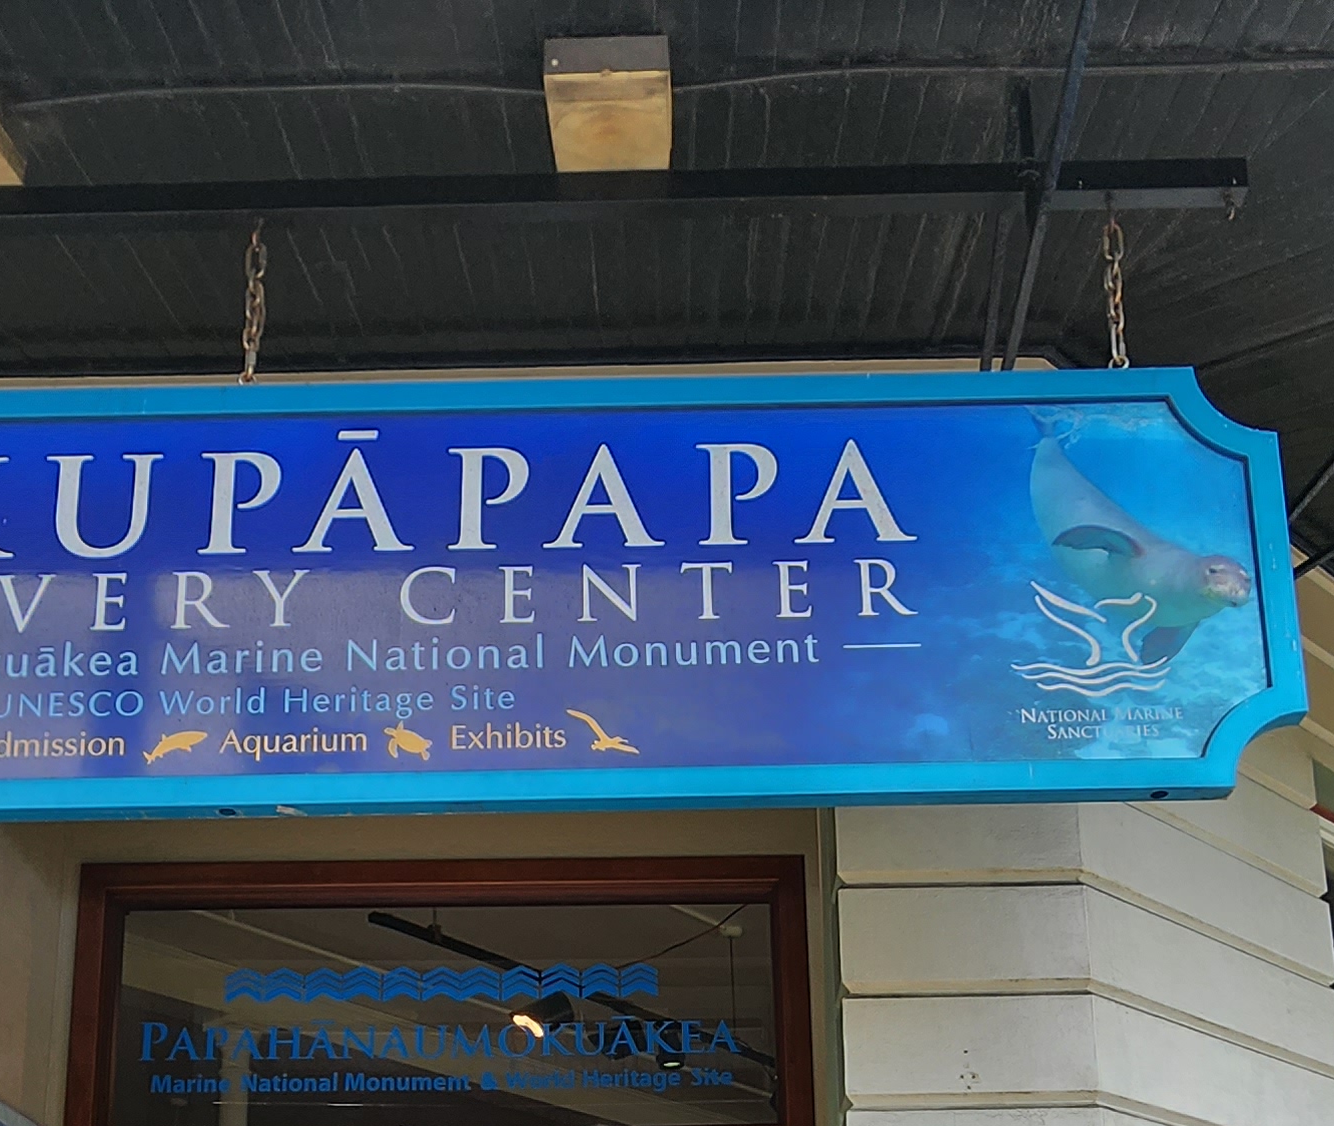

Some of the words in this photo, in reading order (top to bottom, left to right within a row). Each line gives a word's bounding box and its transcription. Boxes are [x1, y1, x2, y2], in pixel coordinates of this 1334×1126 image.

[399, 558, 918, 626] CENTER
[161, 640, 322, 675] Marine
[346, 633, 544, 672] National
[569, 631, 819, 668] Monument
[159, 686, 266, 717] World
[283, 684, 434, 719] Heritage
[451, 683, 516, 712] Site
[1020, 707, 1108, 724] NATIONAL
[220, 726, 367, 758] Aquarium
[450, 722, 567, 750] Exhibits
[137, 1015, 742, 1062] PAPAHĀNAUMOKUĀKEA
[150, 1073, 230, 1094] Marine
[240, 1072, 338, 1093] National
[344, 1071, 471, 1092] Monument
[480, 1071, 498, 1090] &
[505, 1069, 575, 1090] World
[582, 1067, 682, 1092] Heritage
[690, 1067, 734, 1086] Site
